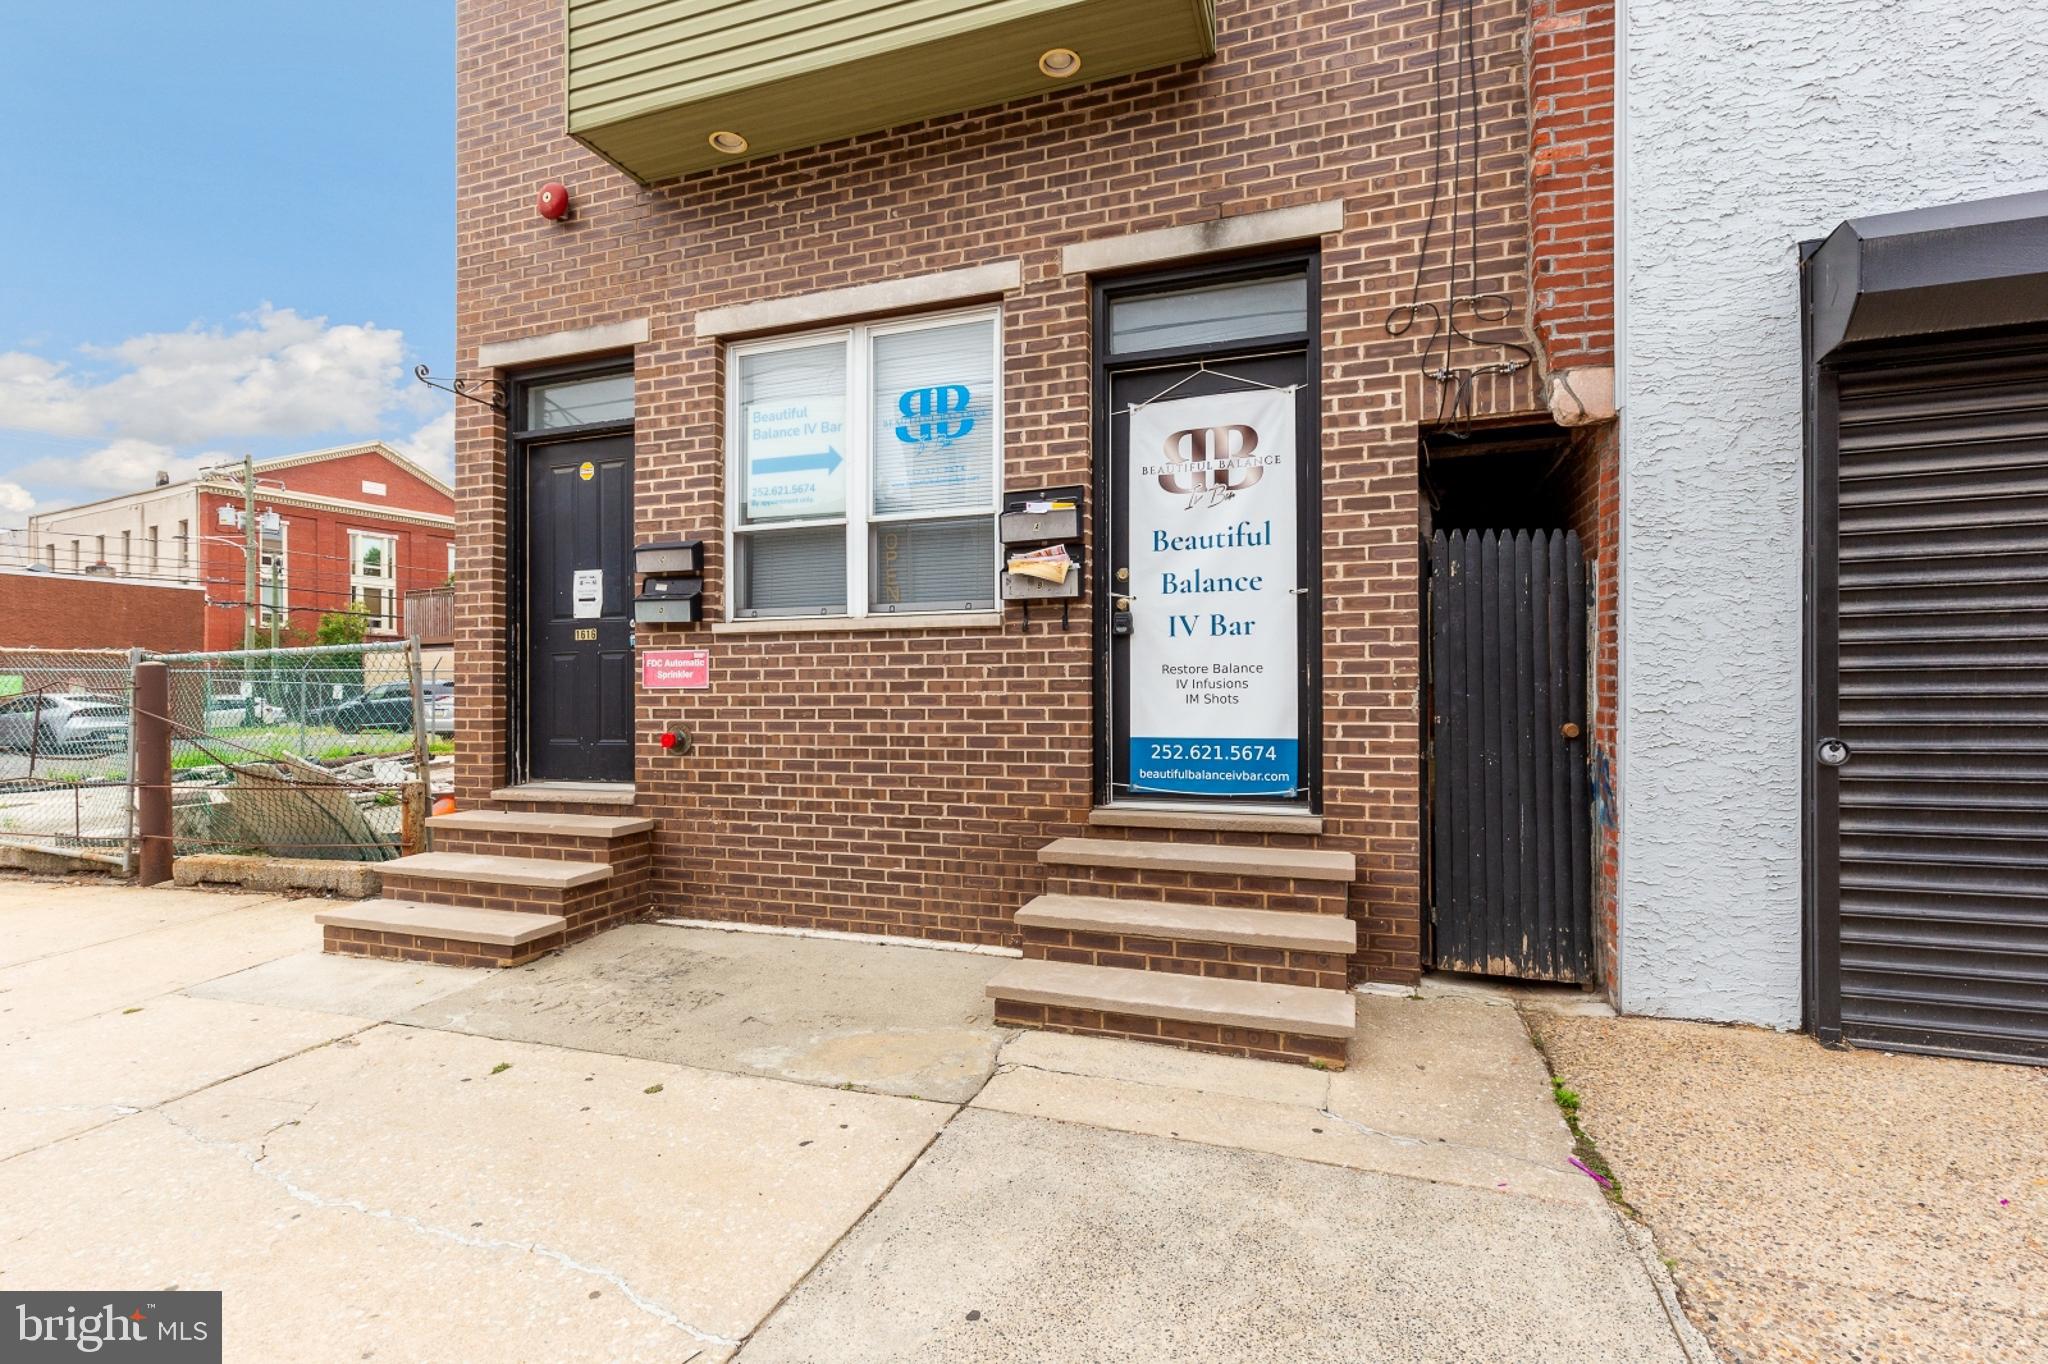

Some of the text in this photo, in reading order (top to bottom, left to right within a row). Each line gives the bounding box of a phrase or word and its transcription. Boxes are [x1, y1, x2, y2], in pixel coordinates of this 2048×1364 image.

[753, 407, 808, 423] Beautiful
[753, 421, 842, 440] Balance IV Bar
[1142, 455, 1281, 476] BEAUTIFUL BALANCE
[752, 483, 816, 497] 252.621.5674
[1152, 520, 1272, 552] Beautiful
[1161, 568, 1263, 595] Balance
[1168, 613, 1256, 638] IV Bar
[576, 628, 596, 640] 1616
[647, 658, 705, 667] FDC Automatic
[1161, 663, 1264, 675] Restore Balance
[657, 670, 694, 680] Sprinkler
[1176, 678, 1249, 689] IV Infusions
[1185, 694, 1239, 705] IM Shots
[1151, 744, 1277, 761] 252.621.5674
[1139, 768, 1290, 782] beautifulbalanceivbar.com
